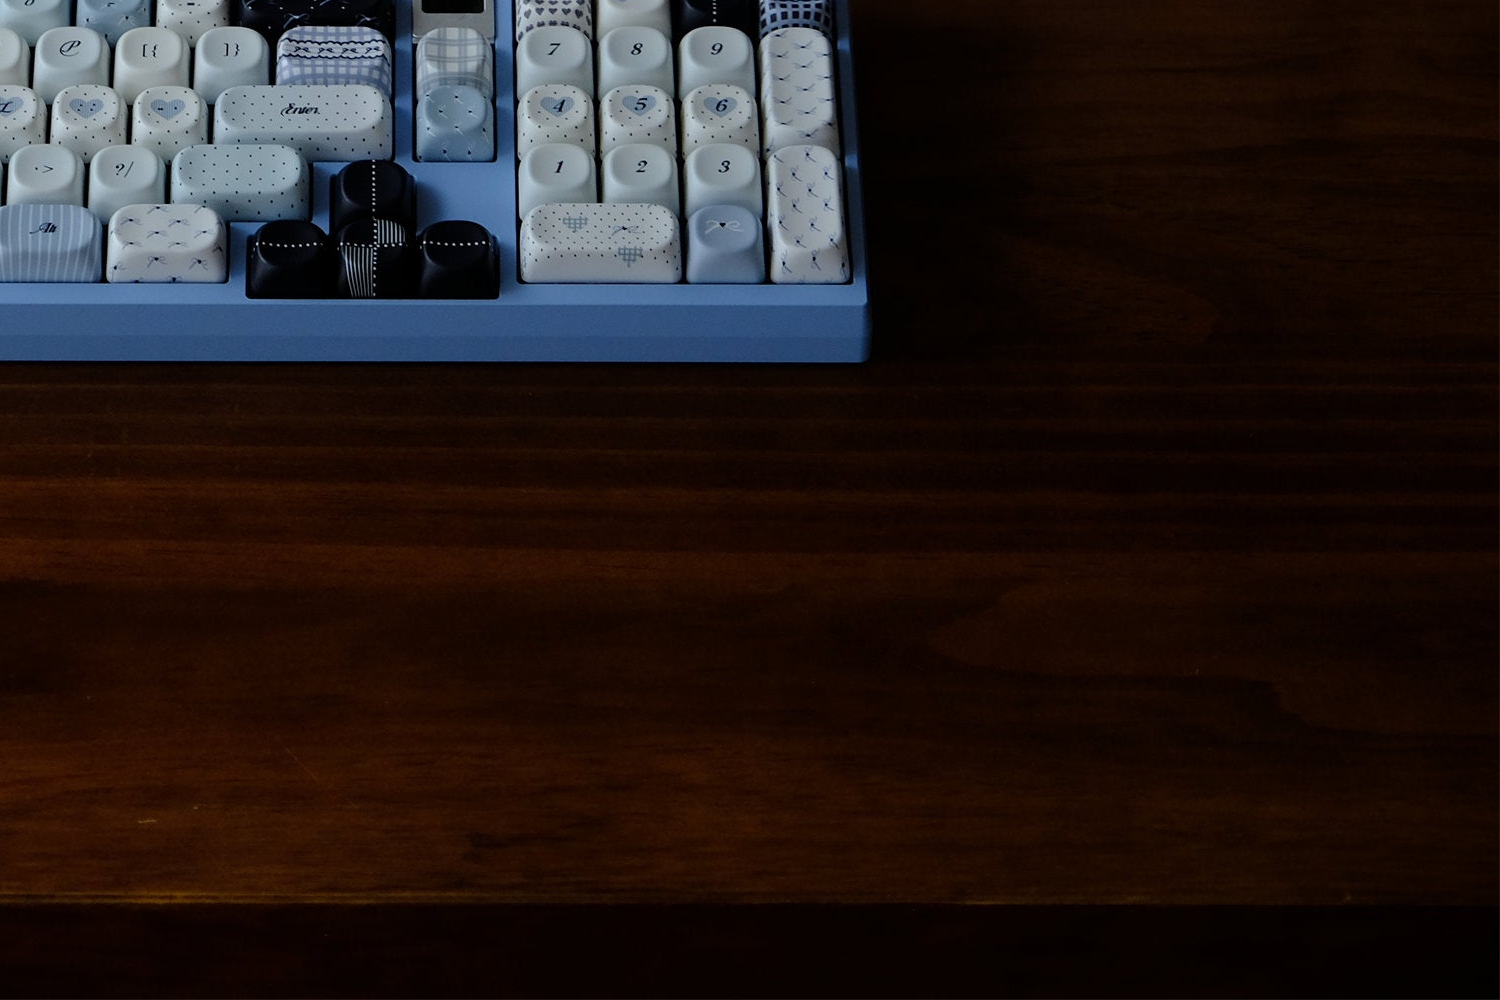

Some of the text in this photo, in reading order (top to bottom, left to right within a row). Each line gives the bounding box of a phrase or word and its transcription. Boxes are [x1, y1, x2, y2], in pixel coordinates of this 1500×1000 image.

[59, 40, 81, 57] P
[548, 43, 560, 56] 7
[630, 43, 643, 56] 8
[710, 43, 723, 56] 9
[280, 102, 320, 117] Enter
[553, 100, 566, 113] 4
[634, 98, 648, 111] 5
[716, 100, 728, 112] 6
[555, 160, 564, 173] 1
[636, 161, 648, 173] 2
[718, 161, 731, 173] 3
[29, 222, 58, 234] Alt
